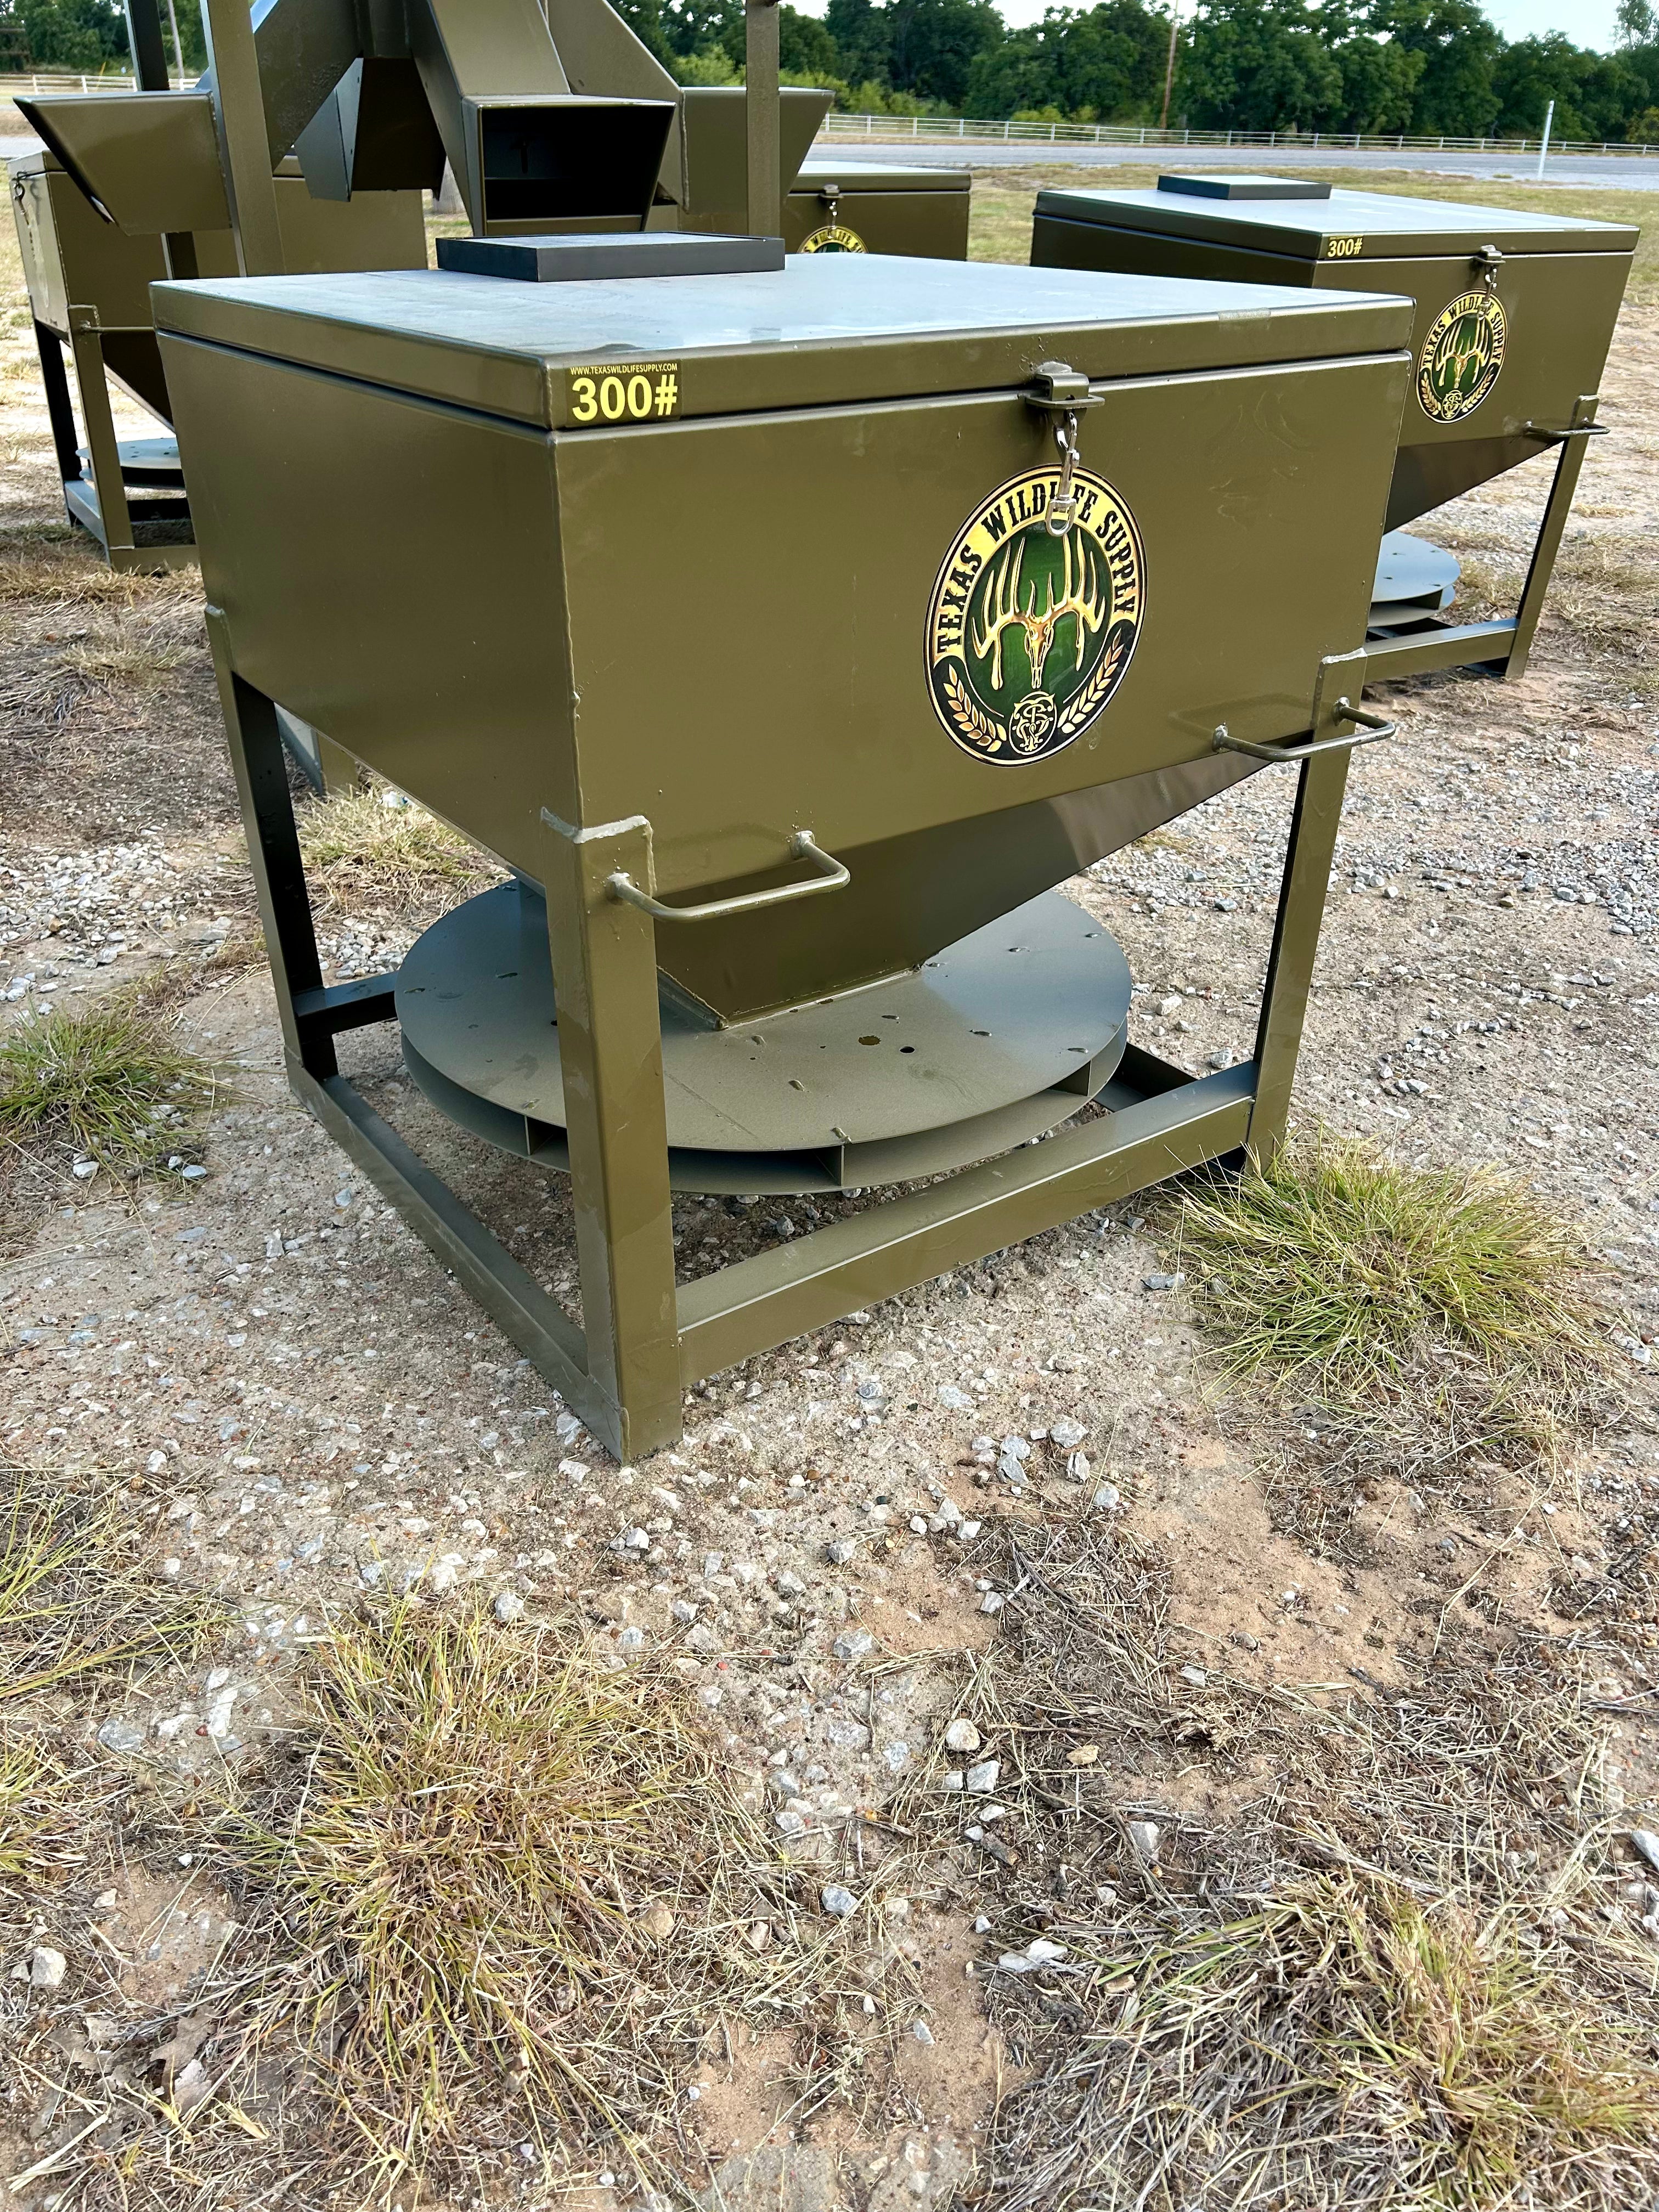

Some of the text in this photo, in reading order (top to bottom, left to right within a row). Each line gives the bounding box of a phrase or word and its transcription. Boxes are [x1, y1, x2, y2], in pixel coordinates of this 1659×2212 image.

[1327, 238, 1363, 257] 300#
[1424, 296, 1504, 365] TEXAS WILDLE SUPPLY
[571, 363, 678, 375] WWW.TEXASWILDLIFESUPPLY.COM
[572, 374, 678, 421] 300#
[937, 481, 1136, 654] TEXAS WILDLFE SUPPLY
